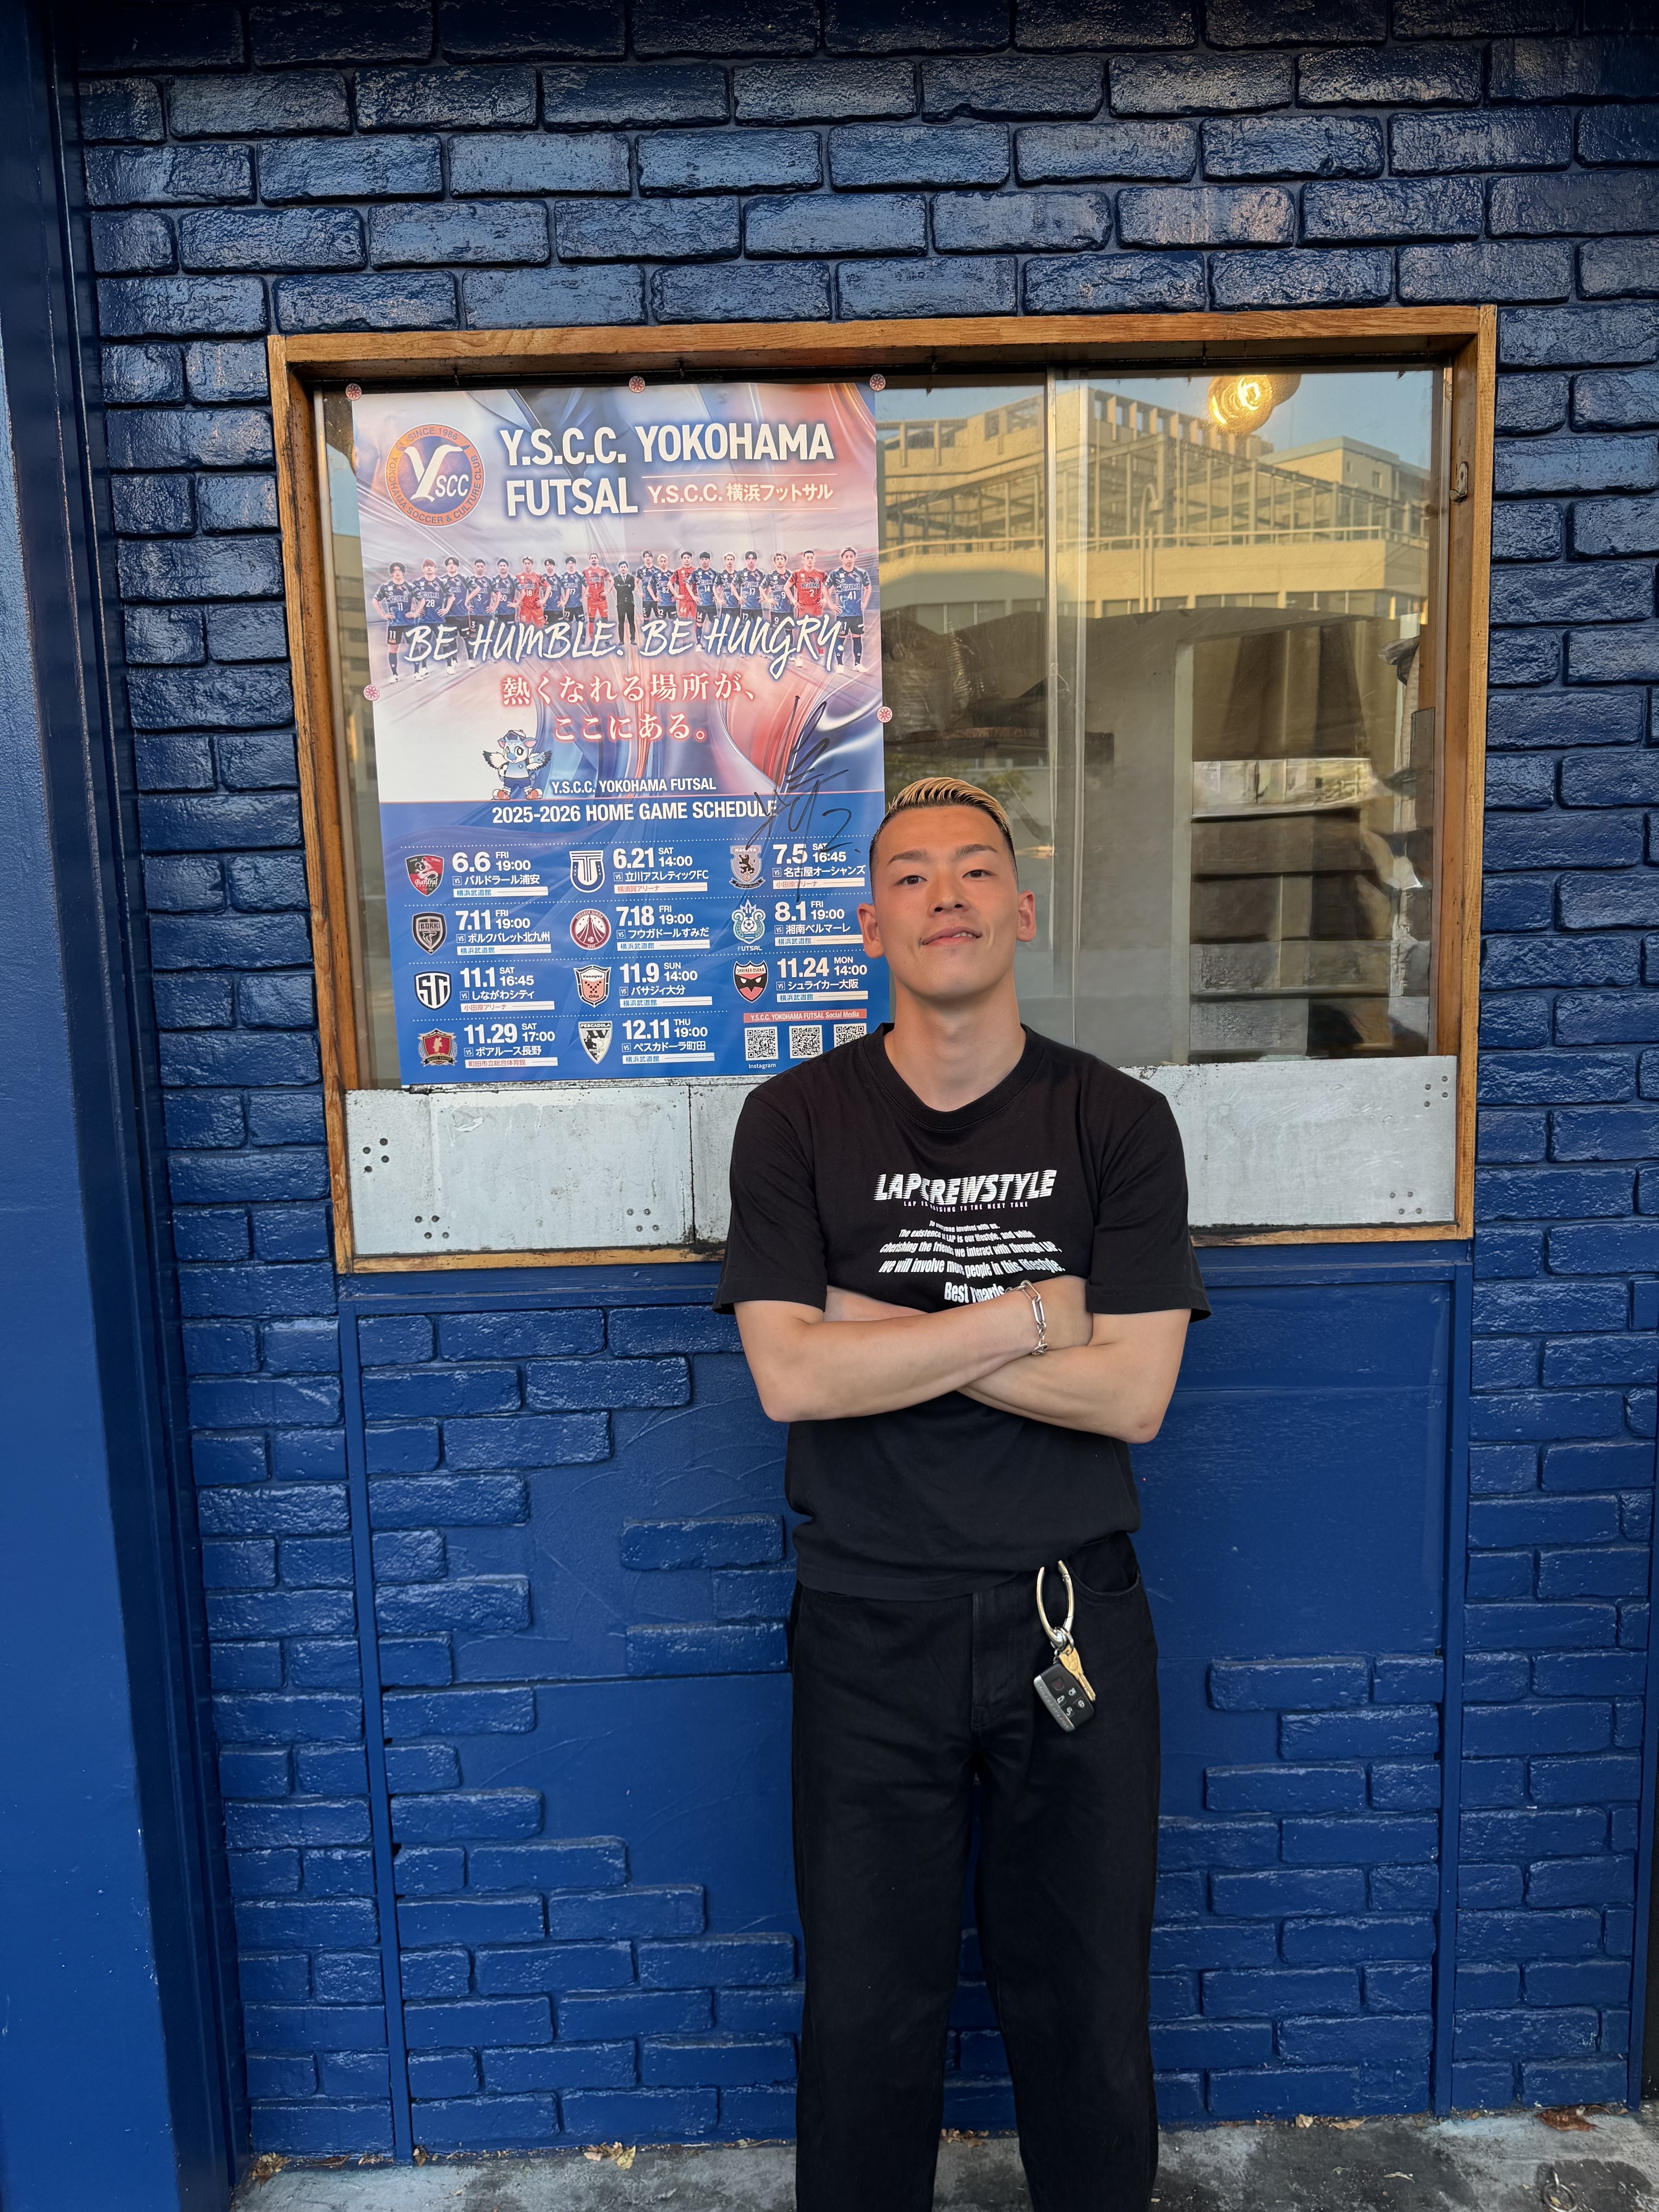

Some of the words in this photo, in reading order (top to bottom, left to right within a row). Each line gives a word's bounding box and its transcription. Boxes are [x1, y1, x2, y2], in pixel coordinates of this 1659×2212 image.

[408, 427, 434, 441] SINCE
[438, 428, 458, 440] 1986
[500, 426, 626, 465] Y.S.C.C.
[635, 422, 834, 462] YOKOHAMA
[389, 457, 407, 509] YOKOHAMA
[407, 507, 443, 523] SOCCER
[453, 483, 481, 518] CULTURE
[471, 455, 481, 480] CLUB
[647, 484, 723, 504] Y.S.C.C.
[726, 483, 833, 502] 横浜フットサル
[507, 477, 638, 516] FUTSAL
[848, 591, 856, 599] 41
[397, 603, 403, 611] 11
[404, 623, 457, 662] BE
[469, 620, 623, 663] HUMBLE.
[640, 618, 693, 656] BE
[704, 613, 844, 680] HUNGRY.
[502, 672, 755, 706] 熱くなれる場所が、
[555, 713, 705, 741] ここにある。
[552, 781, 595, 793] Y.S.C.C.
[599, 779, 667, 793] YOKOHAMA
[671, 778, 716, 791] FUTSAL
[492, 805, 580, 823] 2025-2026
[586, 804, 634, 821] HOME
[639, 802, 687, 819] GAME
[692, 800, 777, 818] SCHEDULE
[613, 848, 654, 869] 6.21
[773, 844, 807, 864] 7.5
[813, 852, 846, 862] 16:45
[452, 852, 491, 872] 6.6
[496, 860, 531, 871] 19:00
[659, 856, 692, 867] 14:00
[625, 870, 709, 881] 立川アスレティックFC
[784, 865, 866, 877] 名古屋オーシャンズ
[465, 874, 540, 885] バルドラール浦安
[616, 906, 654, 926] 7.18
[775, 901, 805, 921] 8.1
[811, 909, 844, 920] 19:00
[455, 910, 491, 930] 7.11
[496, 919, 530, 929] 19:00
[659, 914, 693, 924] 19:00
[628, 927, 709, 939] フウガドールすみだ
[786, 923, 850, 934] 湘南ベルマーレ
[468, 932, 550, 943] ボルクバレット北九州
[620, 963, 659, 983] 11.9
[777, 957, 829, 978] 11.24
[834, 965, 867, 975] 14:00
[460, 967, 495, 988] 11.1
[500, 975, 534, 986] 16:45
[664, 971, 697, 981] 14:00
[631, 985, 685, 995] バサジィ大分
[788, 979, 858, 990] シュライカー大阪
[472, 991, 534, 1000] しながわシティ
[464, 1024, 517, 1044] 11.29
[623, 1019, 670, 1040] 12.11
[674, 1027, 708, 1037] 19:00
[522, 1032, 555, 1042] 17:00
[476, 1046, 541, 1056] ボアルース長野
[634, 1041, 706, 1052] ペスカドーラ町田
[899, 1229, 911, 1237] The
[910, 1229, 941, 1238] existence
[946, 1234, 955, 1243] LAP
[974, 1232, 1001, 1242] lifestyle,
[1000, 1231, 1016, 1239] and
[879, 1242, 918, 1253] cherishing
[919, 1242, 932, 1252] the
[933, 1242, 954, 1256] friends
[954, 1248, 965, 1257] we
[966, 1245, 993, 1257] interact
[993, 1244, 1011, 1255] with
[1009, 1243, 1045, 1253] through
[894, 1258, 913, 1273] will
[911, 1258, 945, 1273] involve
[946, 1261, 965, 1275] more
[965, 1262, 992, 1278] people
[991, 1261, 1003, 1275] in
[1001, 1260, 1023, 1274] this
[1018, 1258, 1065, 1273] lifestyle.
[945, 1282, 969, 1303] Best
